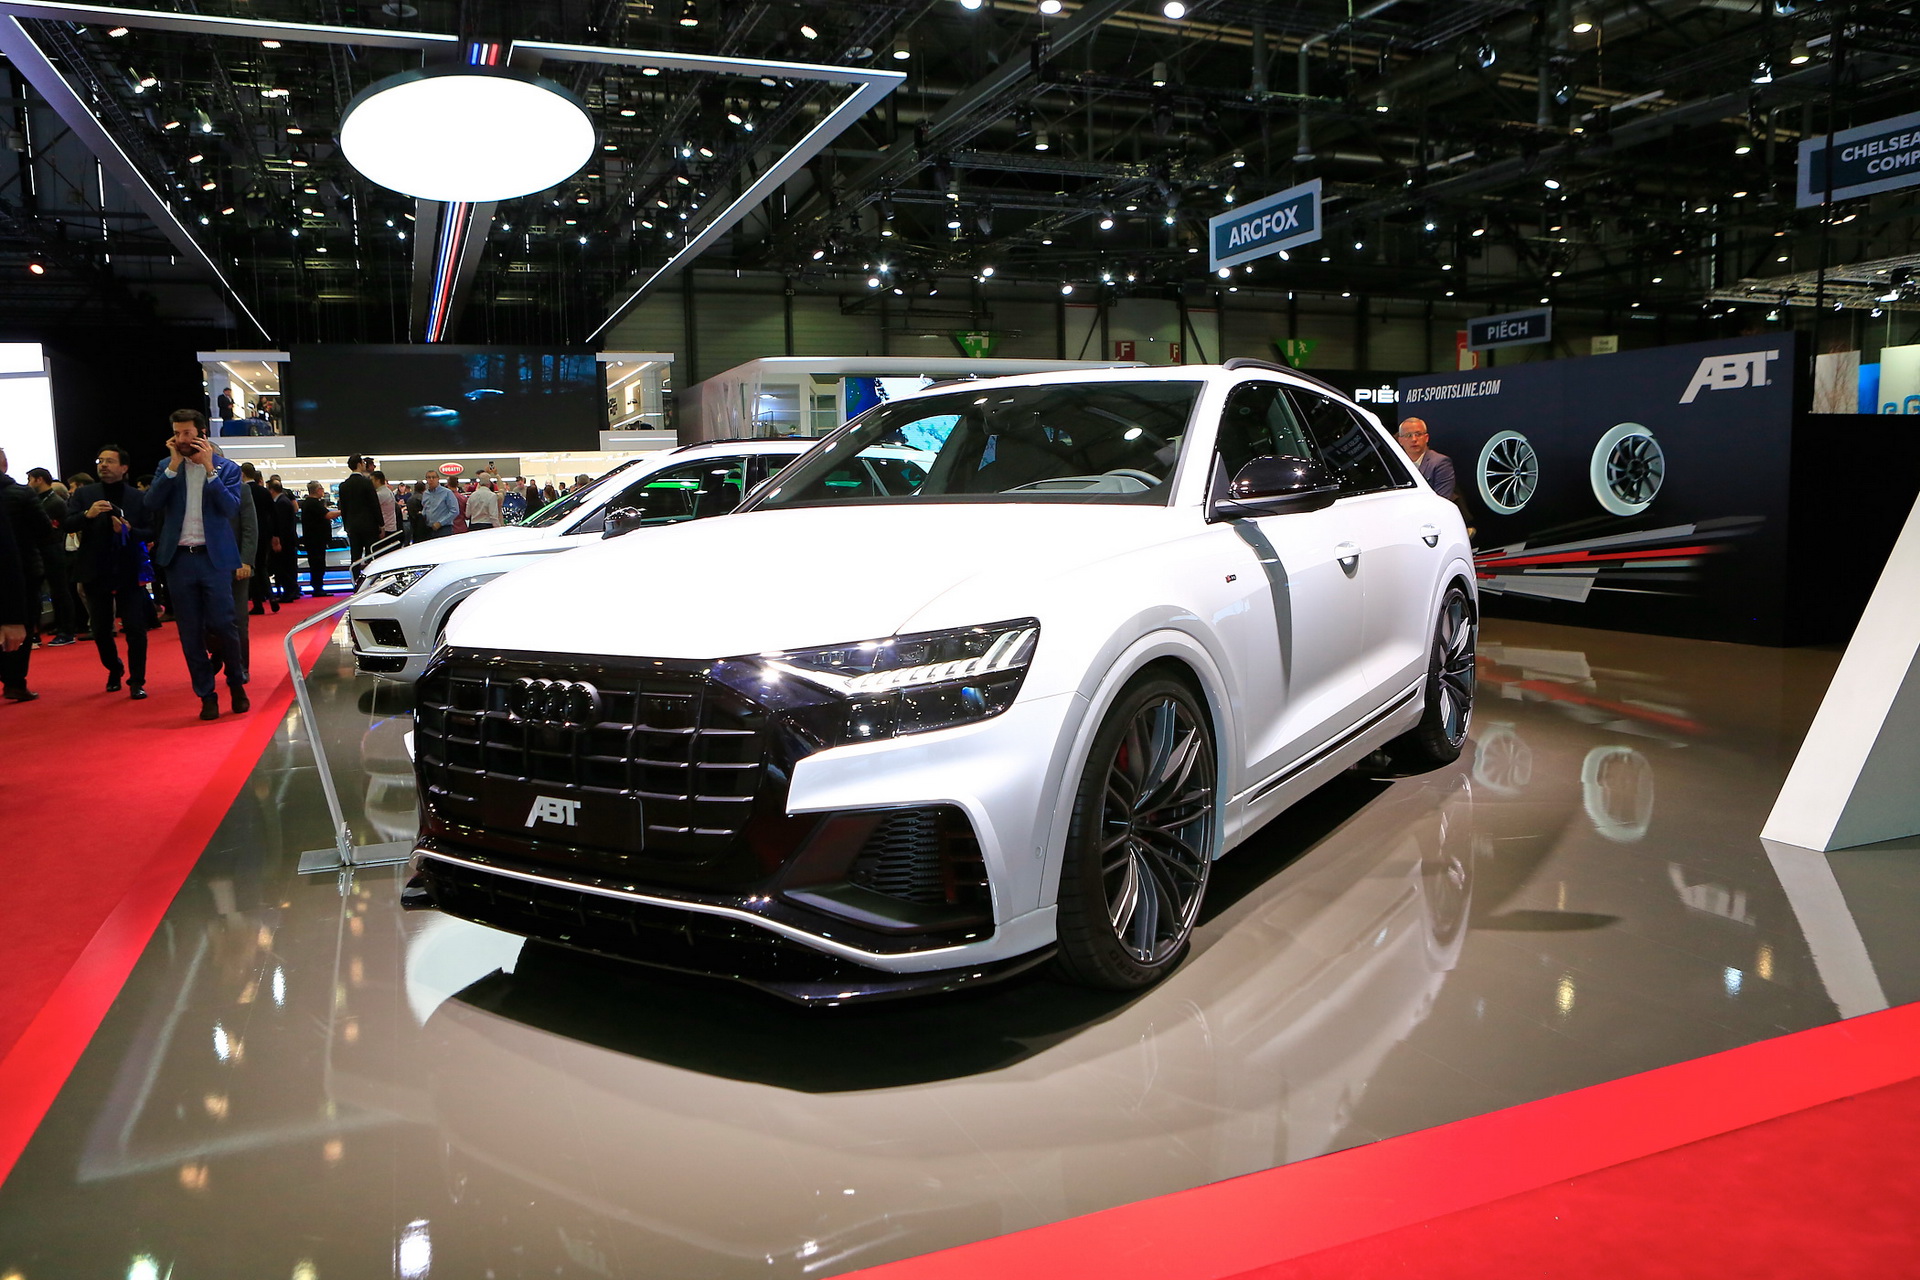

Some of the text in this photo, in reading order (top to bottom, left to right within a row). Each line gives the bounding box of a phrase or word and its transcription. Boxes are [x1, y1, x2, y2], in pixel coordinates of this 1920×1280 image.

[1841, 131, 1920, 162] CHELSEA
[1228, 204, 1299, 249] ARCFOX
[1487, 320, 1529, 340] PIËCH
[1121, 342, 1131, 357] F
[1173, 344, 1179, 358] F
[1679, 349, 1779, 404] ABT
[1406, 379, 1501, 404] ABT-SPORTSLINE.COM
[524, 795, 582, 828] ABT
